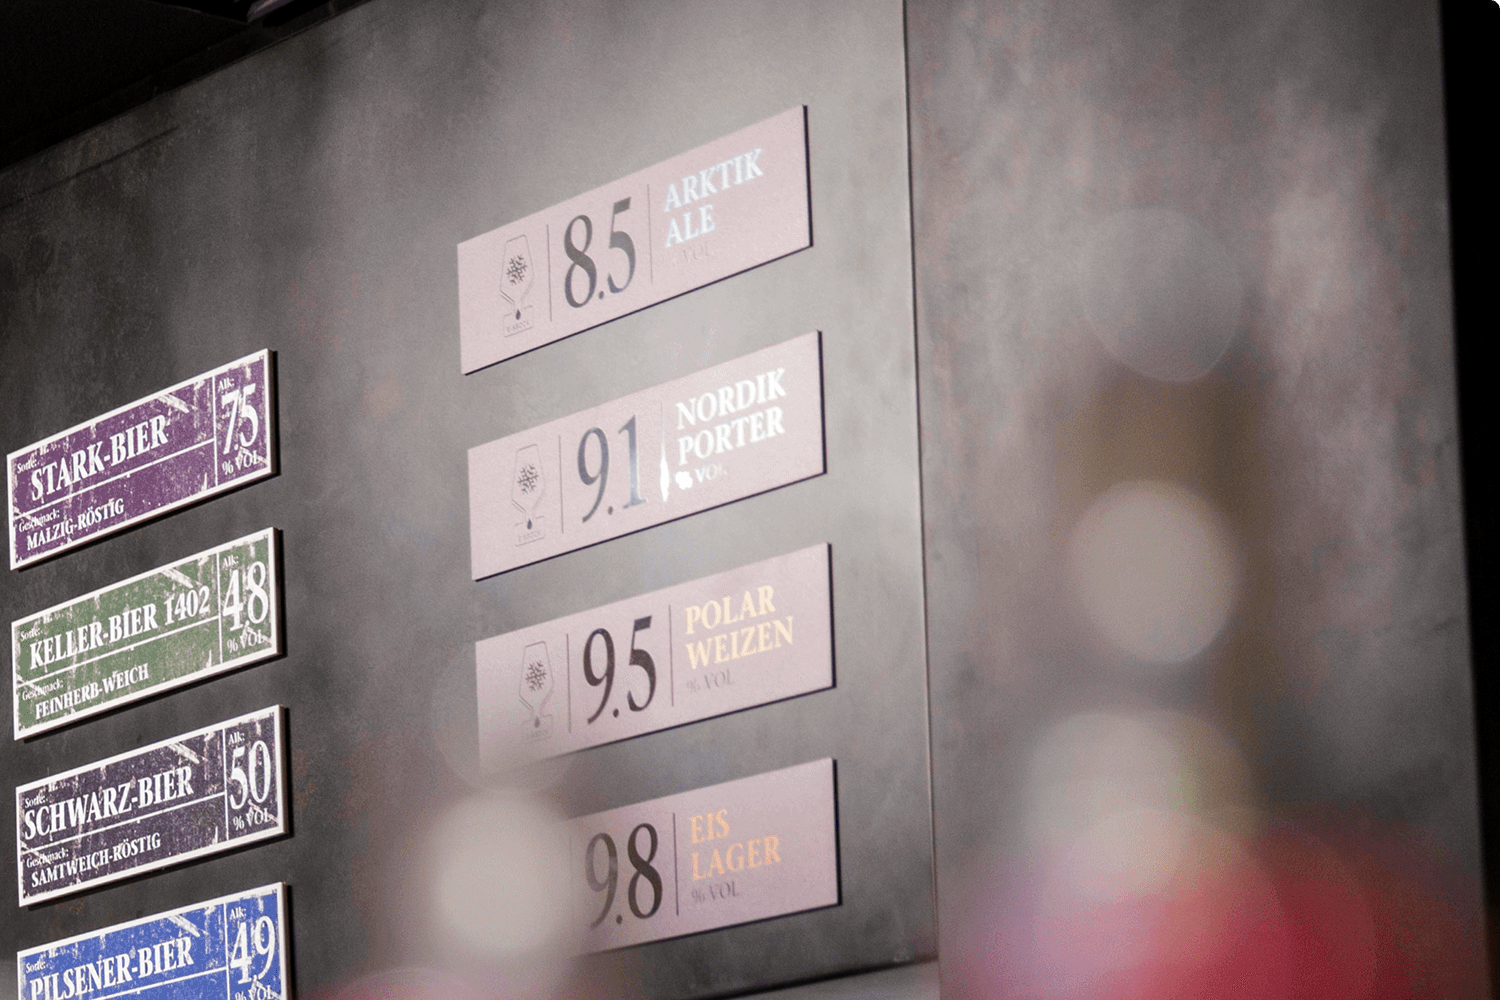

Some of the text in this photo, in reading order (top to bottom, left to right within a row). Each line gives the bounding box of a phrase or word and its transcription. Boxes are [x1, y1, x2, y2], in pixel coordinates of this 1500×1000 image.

[663, 148, 764, 212] ARKTIK
[564, 196, 636, 308] 8.5
[665, 204, 716, 248] ALE
[676, 368, 787, 429] NORDIK
[30, 414, 169, 502] STARK-BIER
[677, 405, 786, 466] PORTER
[577, 414, 647, 524] 9.1
[26, 497, 125, 551] MALZIG-RÖSTIG
[30, 585, 211, 670] KELLER-BIER 1402
[685, 584, 777, 635] POLAR
[583, 615, 657, 725] 9.5
[686, 616, 794, 669] WEIZEN
[35, 663, 149, 720] FEINHERB-WEICH
[24, 766, 194, 841] SCHWARZ-BIER
[689, 808, 731, 844] EIS
[31, 832, 162, 888] SAMTWEICH-RÖSTIG
[585, 823, 663, 930] 9.8
[691, 834, 782, 882] LAGER
